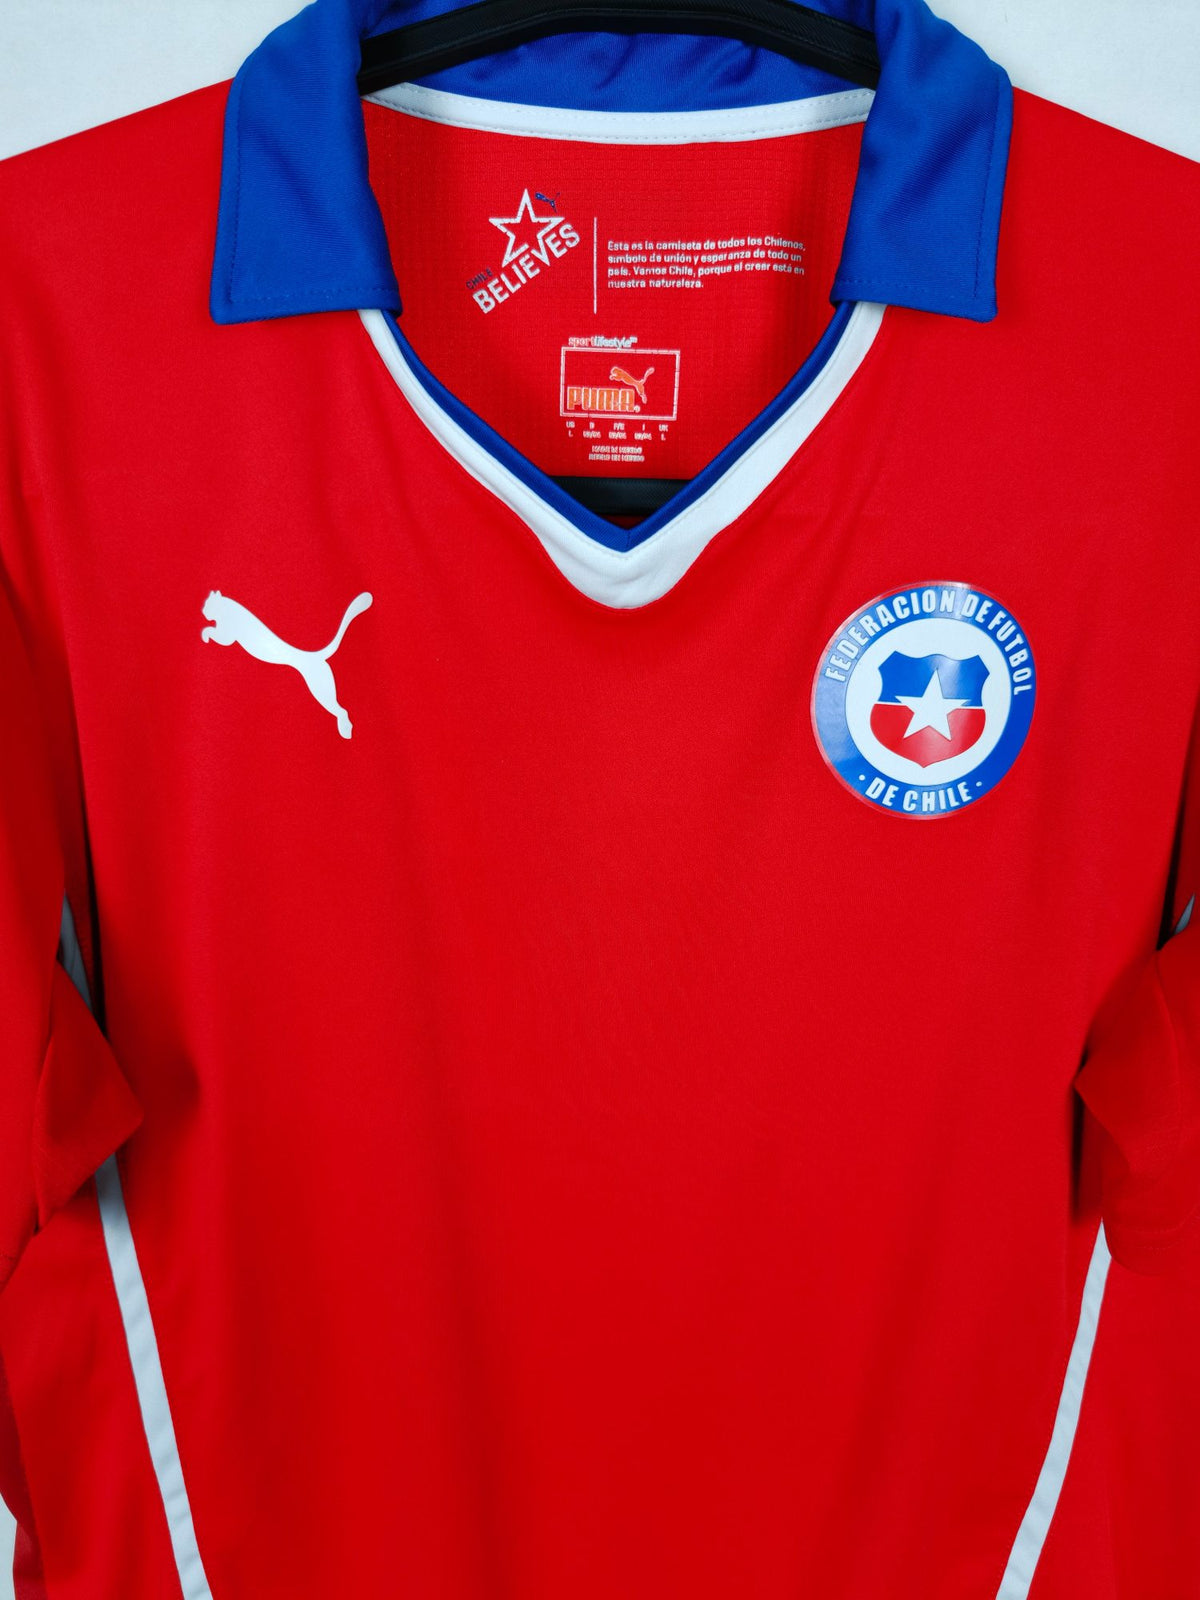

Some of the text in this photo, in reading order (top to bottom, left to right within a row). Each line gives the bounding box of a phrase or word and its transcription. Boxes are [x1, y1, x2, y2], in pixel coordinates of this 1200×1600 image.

[607, 240, 629, 251] Esta
[631, 241, 643, 250] es
[645, 240, 654, 250] la
[656, 240, 701, 250] camiseta
[703, 239, 716, 250] de
[718, 237, 745, 249] todos
[747, 236, 762, 246] los
[649, 252, 662, 263] de
[664, 252, 692, 263] unión
[693, 255, 699, 265] y
[700, 250, 751, 264] esperanza
[753, 248, 765, 258] de
[768, 249, 789, 260] todo
[791, 254, 802, 262] un
[472, 223, 580, 314] BELIEVES
[633, 266, 667, 275] Vamos
[669, 265, 696, 278] Chile,
[697, 263, 732, 278] porque
[734, 261, 743, 272] el
[794, 267, 805, 275] en
[607, 278, 704, 289] nuestra naturaleza.
[566, 386, 636, 412] PUMA
[825, 589, 1033, 695] FEDERACION DE FUTBOL
[865, 777, 973, 812] DE CHILE
